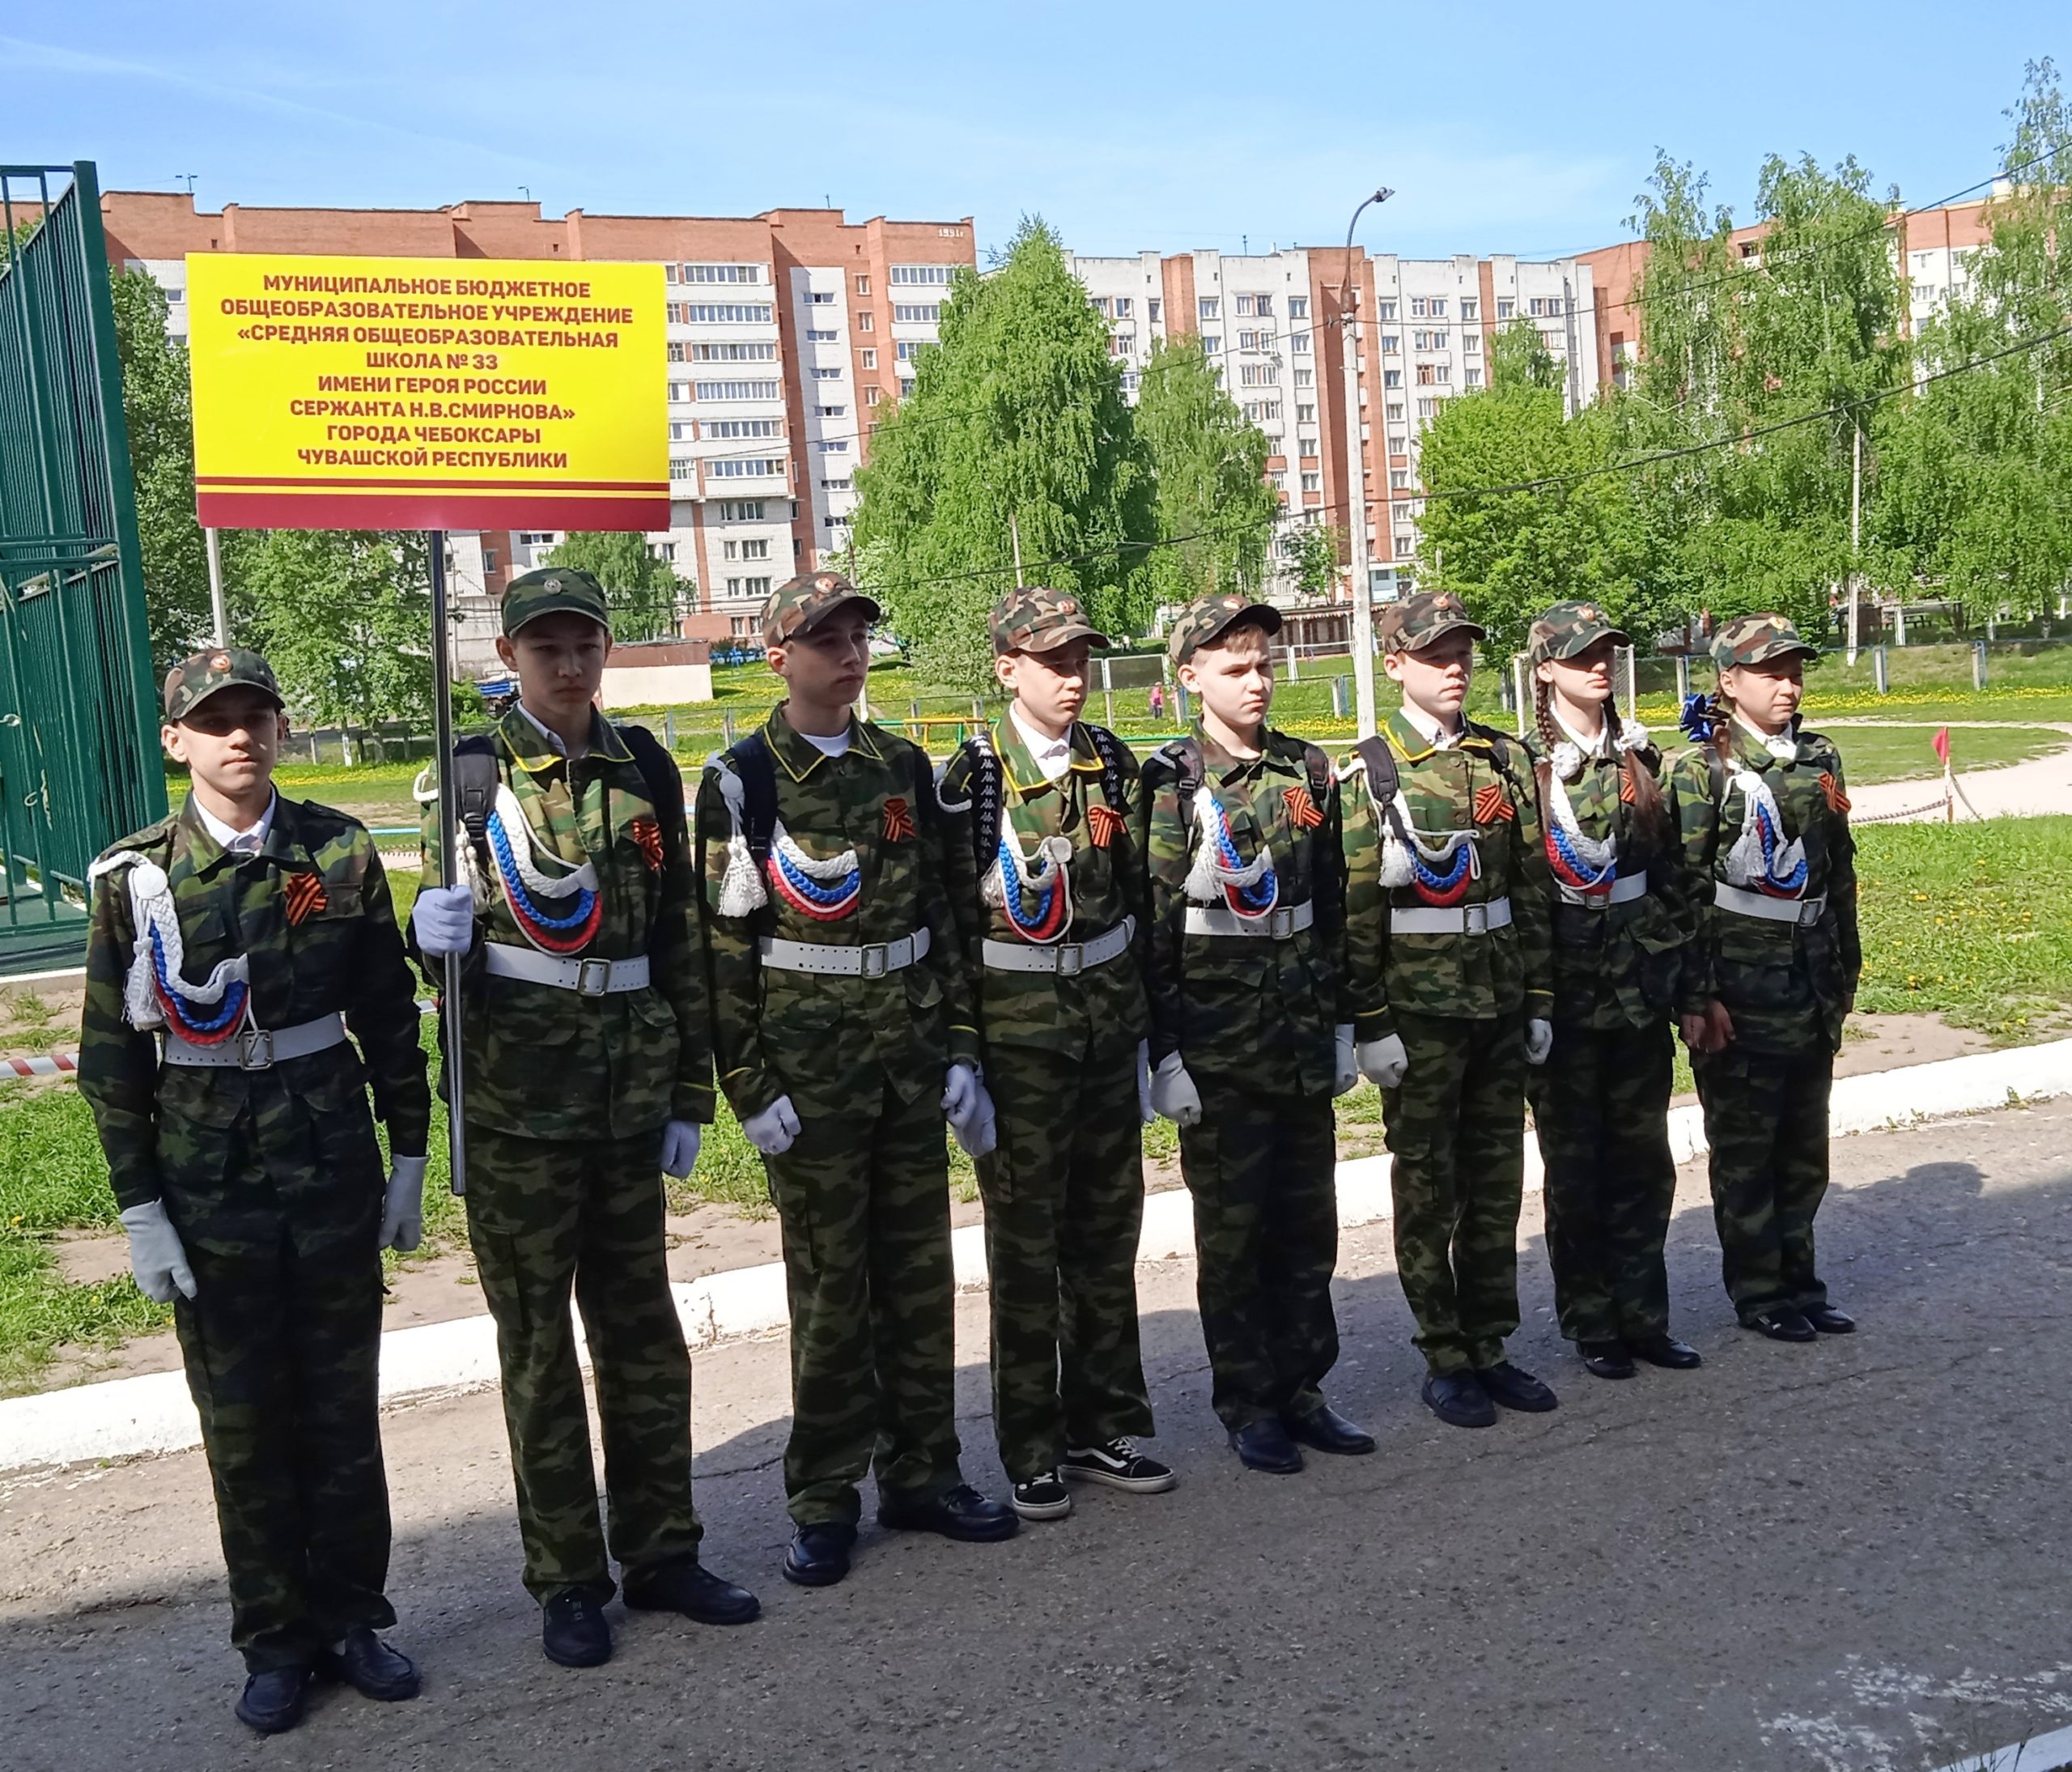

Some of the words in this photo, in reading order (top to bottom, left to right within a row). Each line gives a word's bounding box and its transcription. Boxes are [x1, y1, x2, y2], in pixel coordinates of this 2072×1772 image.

[263, 275, 452, 295] МУНИЦИПАЛЬНОЕ
[456, 280, 591, 299] БЮДЖЕТНОЕ
[220, 299, 489, 321] ОБЩЕОБРАЗОВАТЕЛЬНОЕ
[491, 305, 633, 325] УЧРЕЖДЕНИЕ
[237, 325, 349, 345] «СРЕДНЯЯ
[353, 327, 618, 348] ОБЩЕОБРАЗОВАТЕЛЬНАЯ
[366, 352, 443, 369] ШКОЛА
[446, 354, 469, 368] №
[472, 355, 499, 370] 33
[318, 376, 391, 393] ИМЕНИ
[395, 377, 461, 394] ГЕРОЯ
[464, 379, 546, 396] РОССИИ
[290, 400, 406, 418] СЕРЖАНТА
[410, 402, 575, 420] Н.В.СМИРНОВА»
[327, 426, 411, 444] ГОРОДА
[414, 427, 541, 444] ЧЕБОКСАРЫ
[297, 448, 428, 466] ЧУВАШСКОЙ
[431, 451, 567, 469] РЕСПУБЛИКИ
